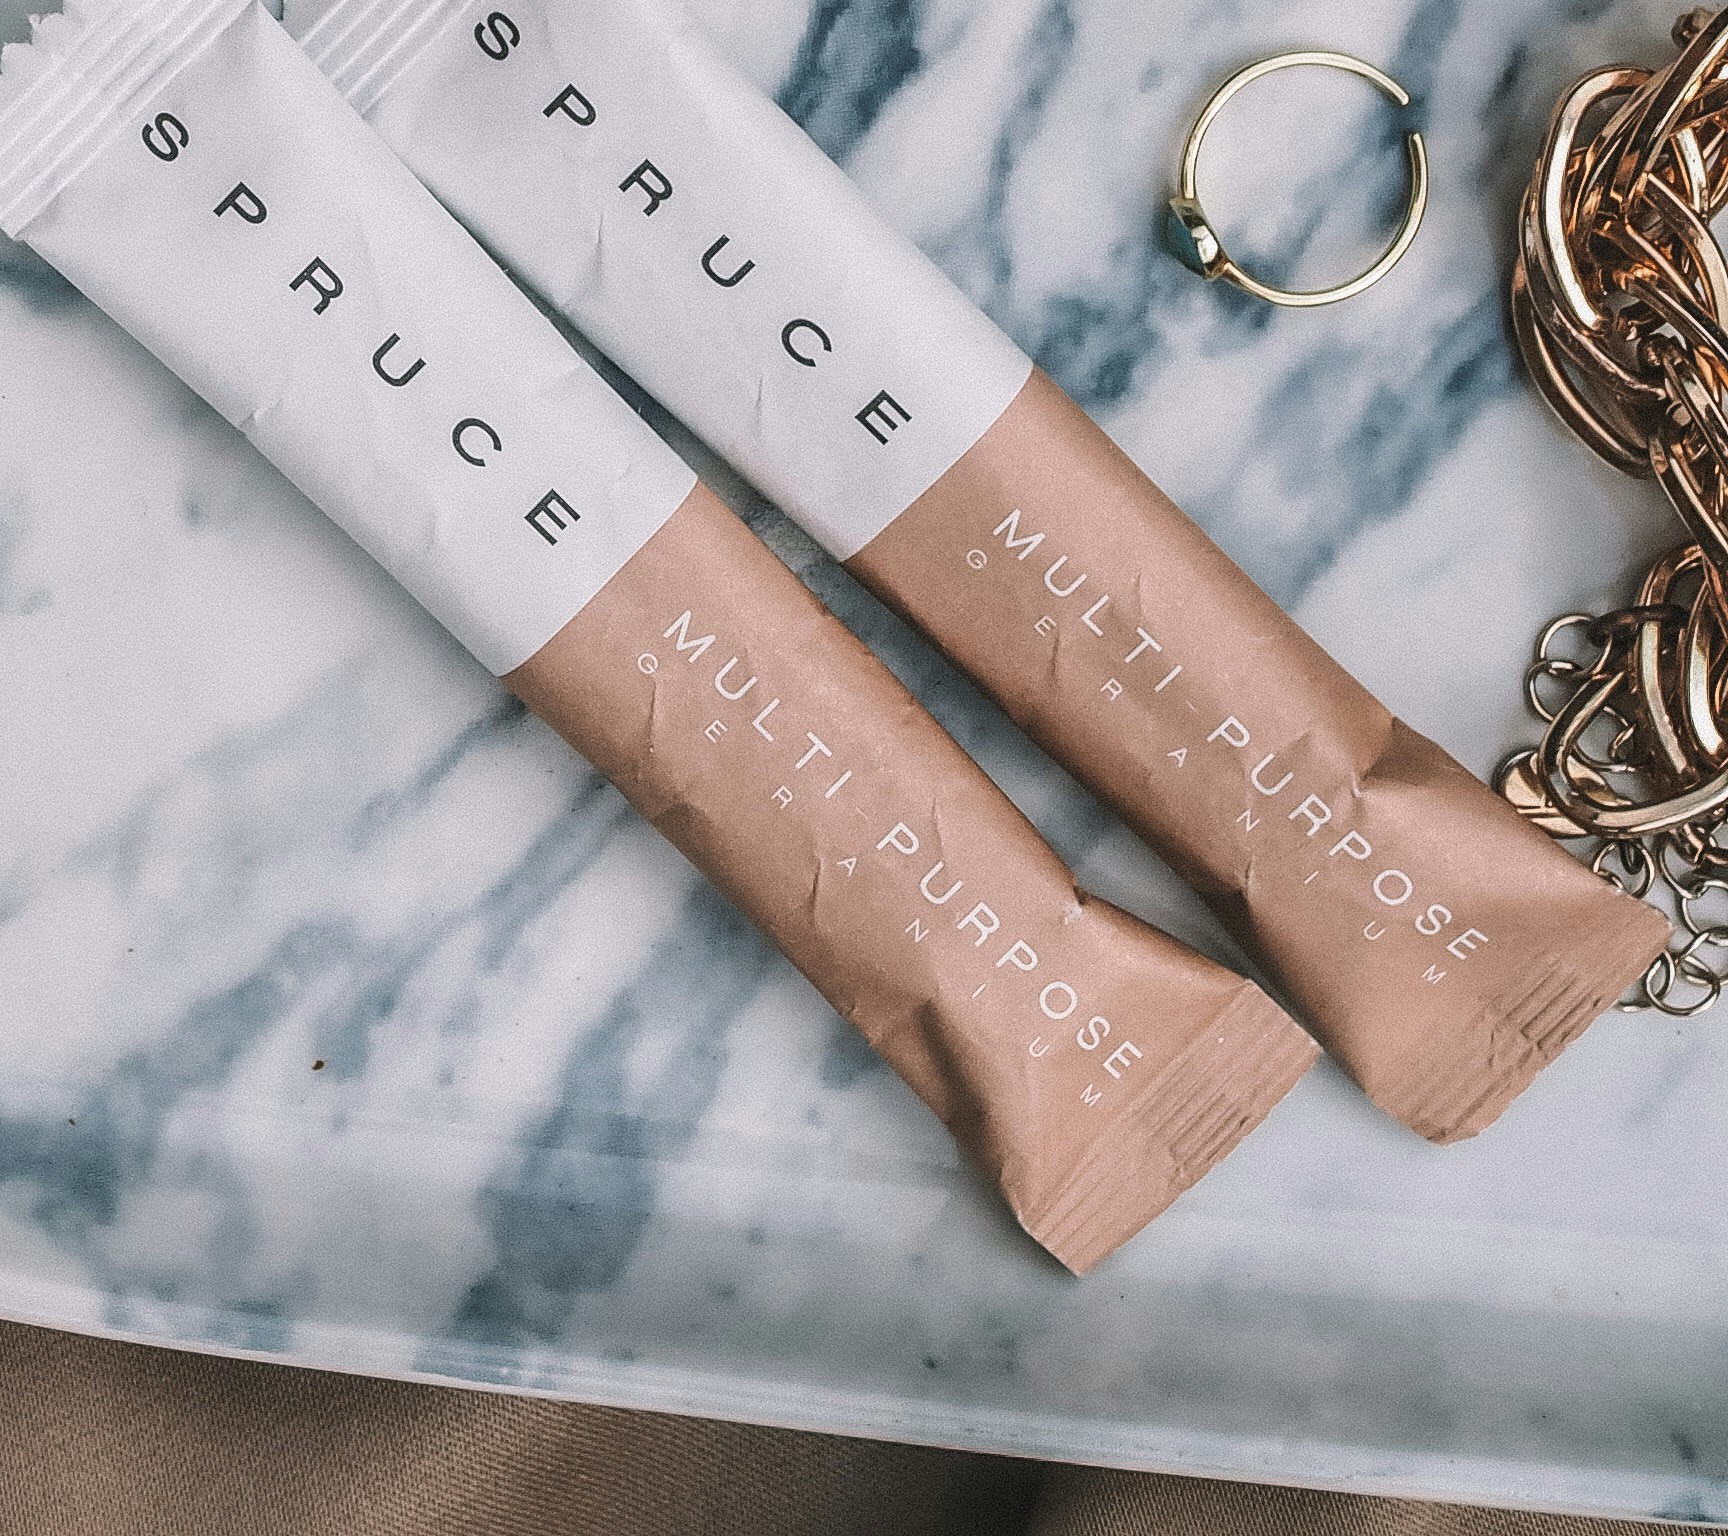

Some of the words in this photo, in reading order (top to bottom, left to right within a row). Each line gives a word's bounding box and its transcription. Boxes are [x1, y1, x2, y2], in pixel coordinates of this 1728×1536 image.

[141, 112, 582, 547] SPRUCE
[473, 10, 913, 446] SPRUCE
[637, 652, 1103, 1107] GERANIUM
[966, 548, 1447, 985] GERANIUM
